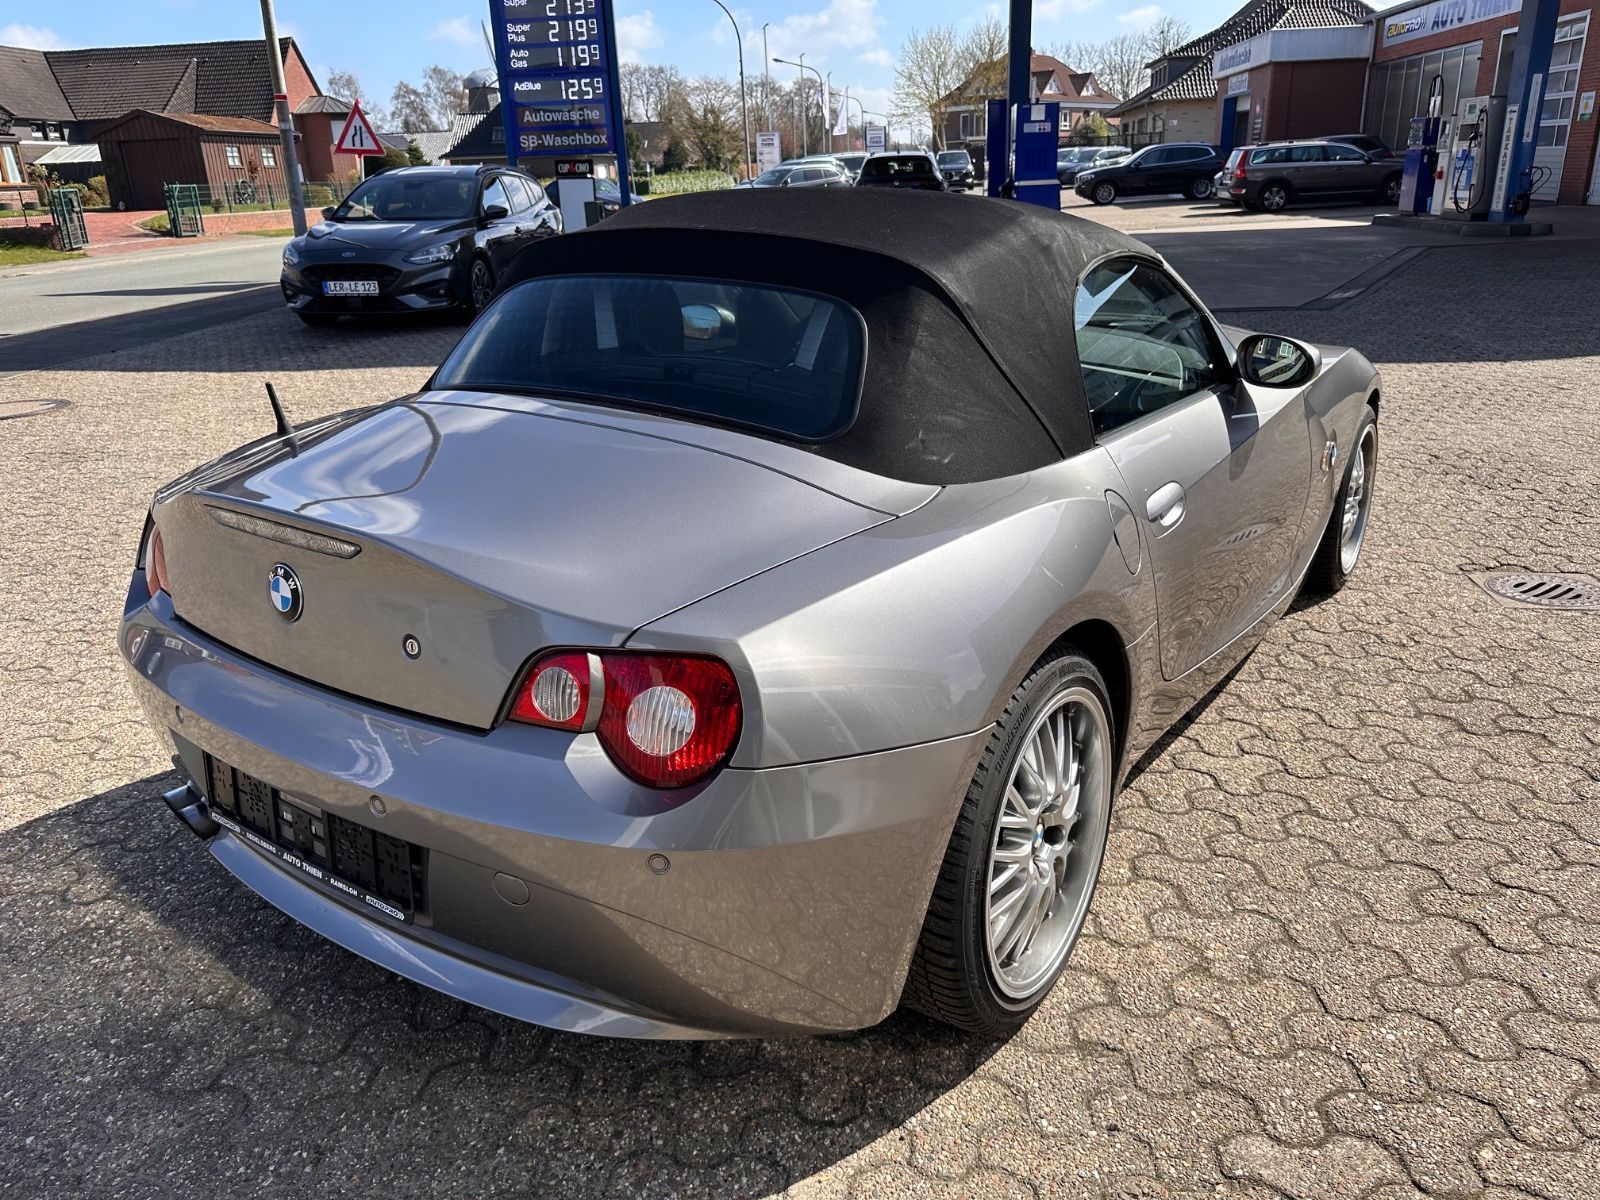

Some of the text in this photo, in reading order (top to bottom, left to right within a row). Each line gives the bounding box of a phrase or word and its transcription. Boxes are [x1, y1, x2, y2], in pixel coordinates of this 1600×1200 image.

[503, 0, 528, 9] Super
[1431, 1, 1467, 31] AUTO
[506, 23, 531, 34] Super
[507, 33, 526, 42] Plus
[509, 49, 529, 58] Auto
[510, 59, 528, 68] Gas
[513, 81, 542, 91] AdBlue
[523, 107, 600, 123] Autowäsche
[519, 132, 608, 148] SB-Waschbox
[328, 282, 377, 293] LER LE 123
[268, 566, 297, 590] BMW
[283, 852, 301, 867] AUTO
[302, 862, 323, 879] THIEN
[330, 878, 358, 896] RAMSLOH
